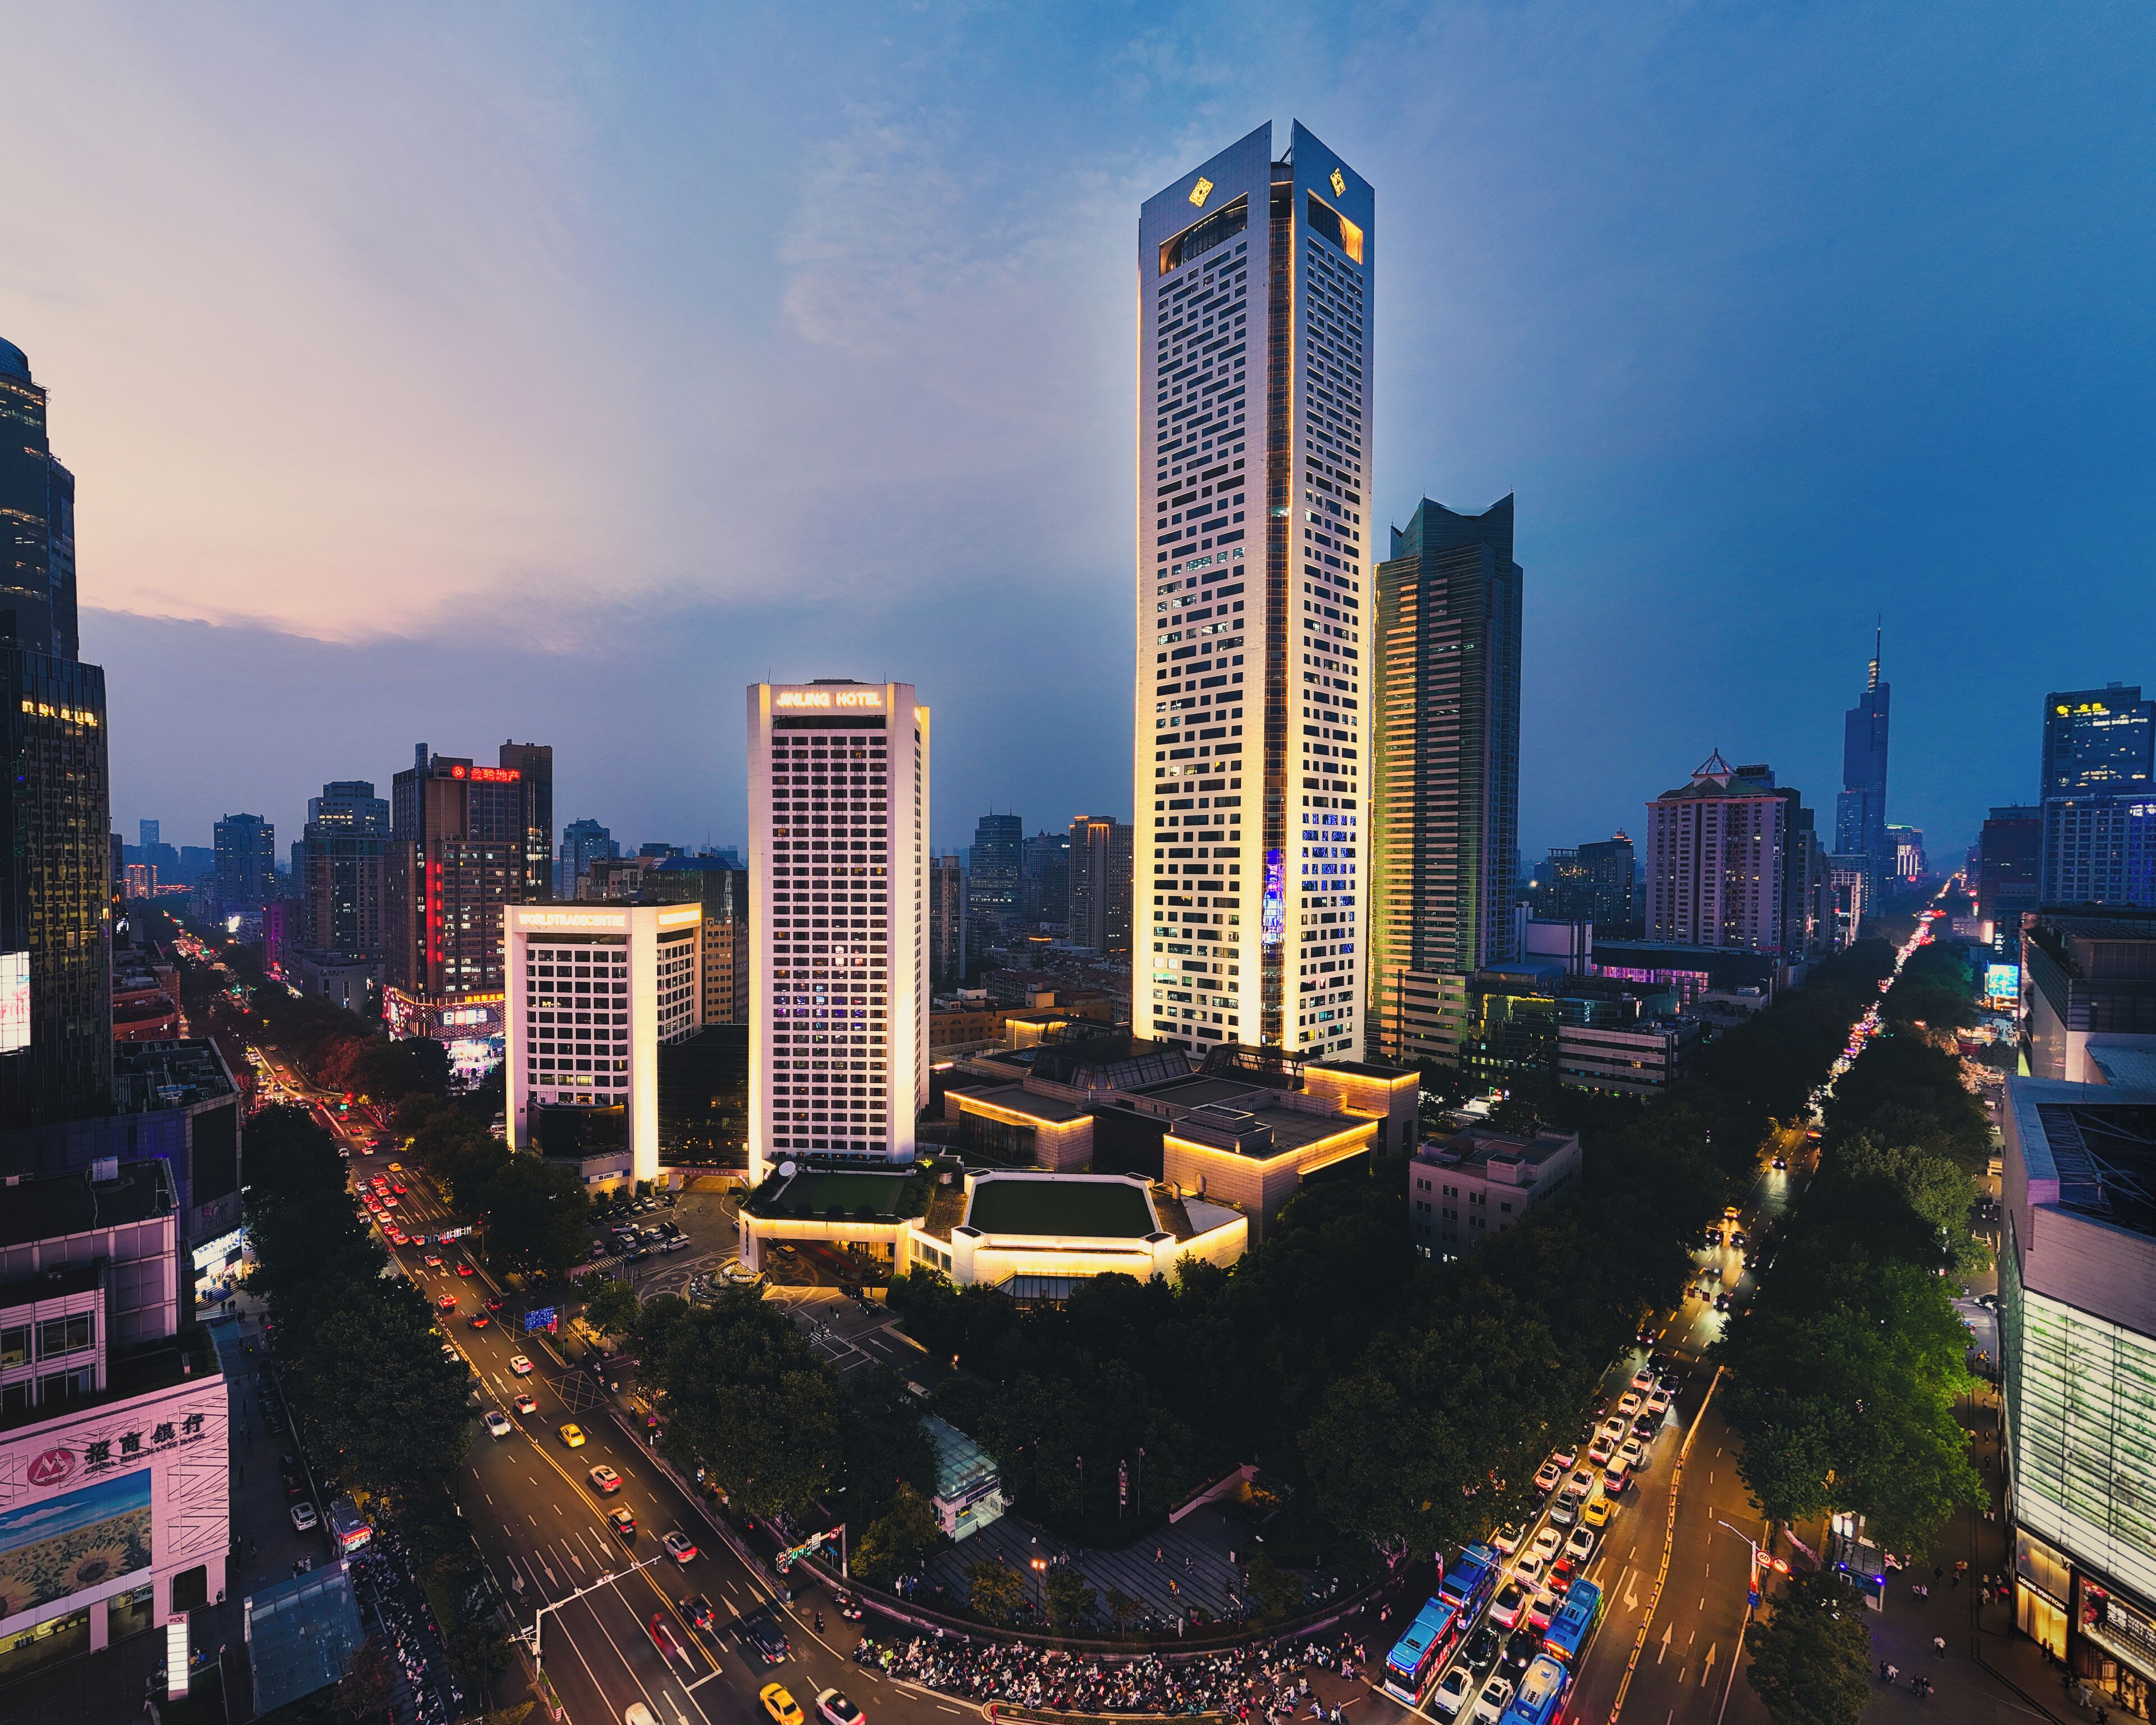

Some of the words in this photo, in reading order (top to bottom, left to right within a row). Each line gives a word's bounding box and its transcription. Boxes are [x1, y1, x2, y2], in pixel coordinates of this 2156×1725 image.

[776, 693, 830, 706] JINLING
[836, 692, 881, 705] HOTEL
[471, 768, 520, 782] 金轮地产
[85, 1461, 118, 1474] CHINA
[119, 1441, 179, 1464] MERCHANTS
[179, 1433, 206, 1446] BANK
[2018, 1576, 2037, 1591] LOUIS
[2038, 1589, 2066, 1610] VUITTON
